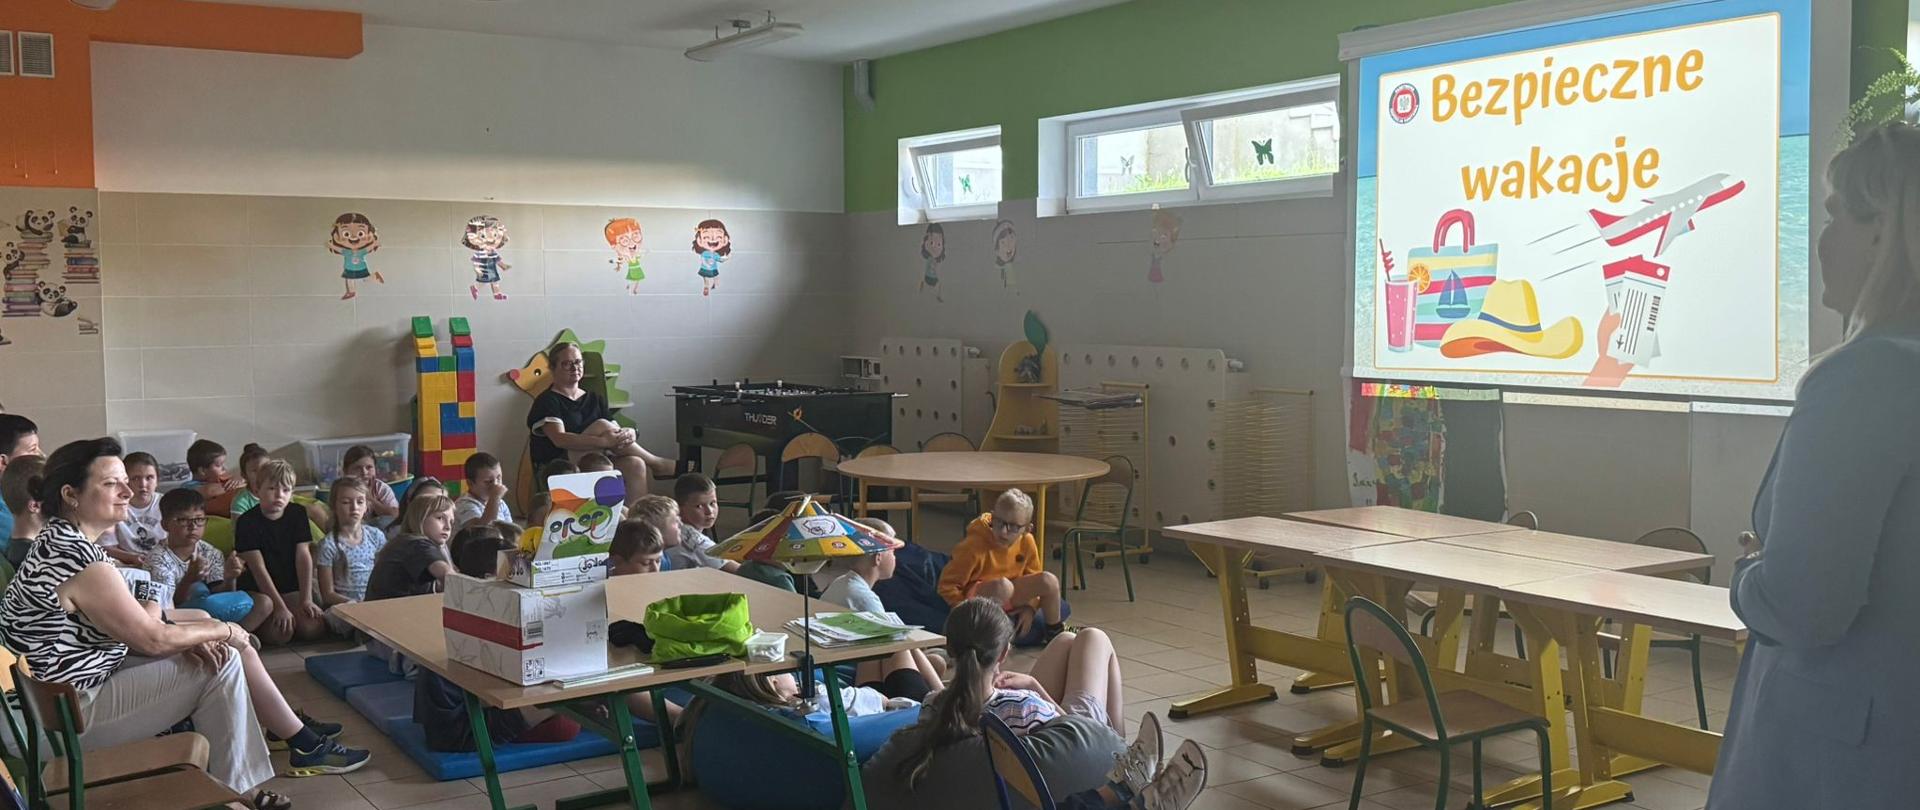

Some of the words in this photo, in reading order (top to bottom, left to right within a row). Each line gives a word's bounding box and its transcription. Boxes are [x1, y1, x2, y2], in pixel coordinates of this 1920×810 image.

[1431, 49, 1704, 125] Bezpieczne
[1461, 137, 1660, 203] wakacje
[744, 412, 777, 426] THUNDER
